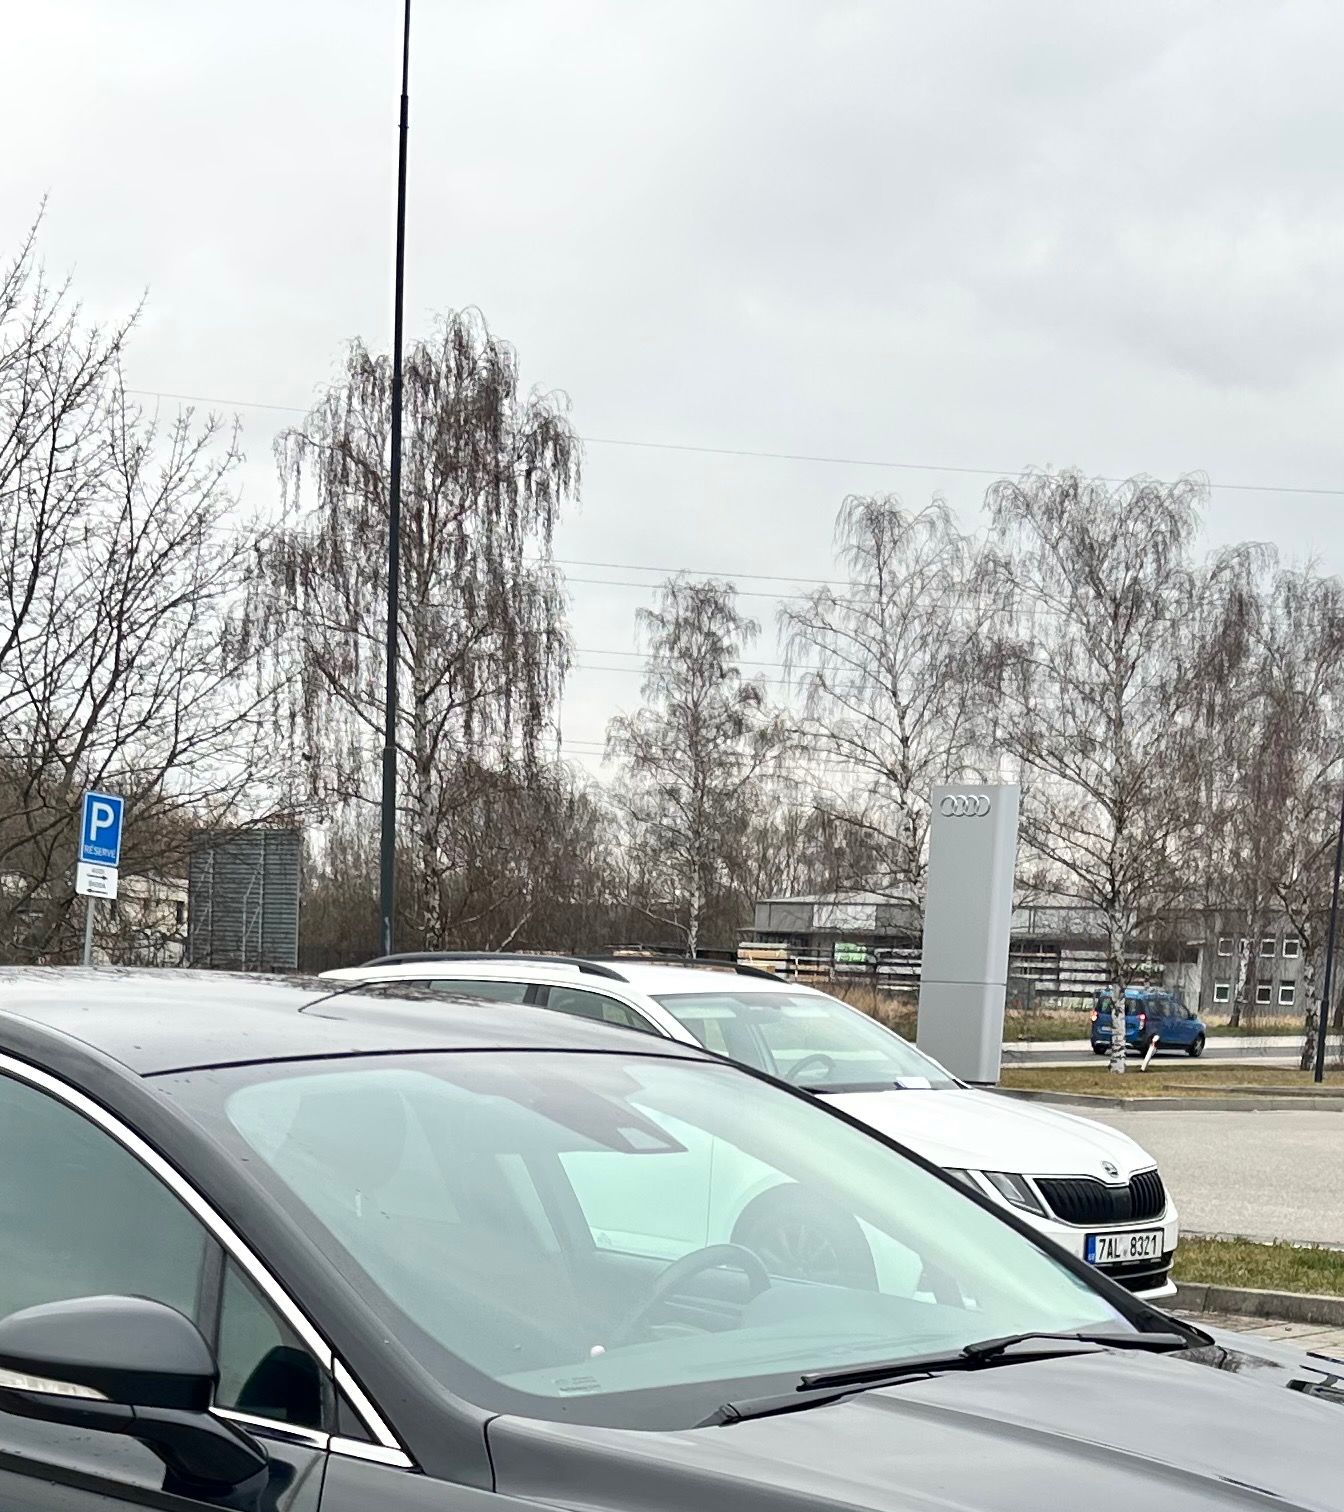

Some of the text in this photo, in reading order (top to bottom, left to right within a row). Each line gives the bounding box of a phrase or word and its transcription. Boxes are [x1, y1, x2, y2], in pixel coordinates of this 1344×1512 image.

[90, 801, 115, 841] P
[1099, 1235, 1157, 1260] 7AL 8321
